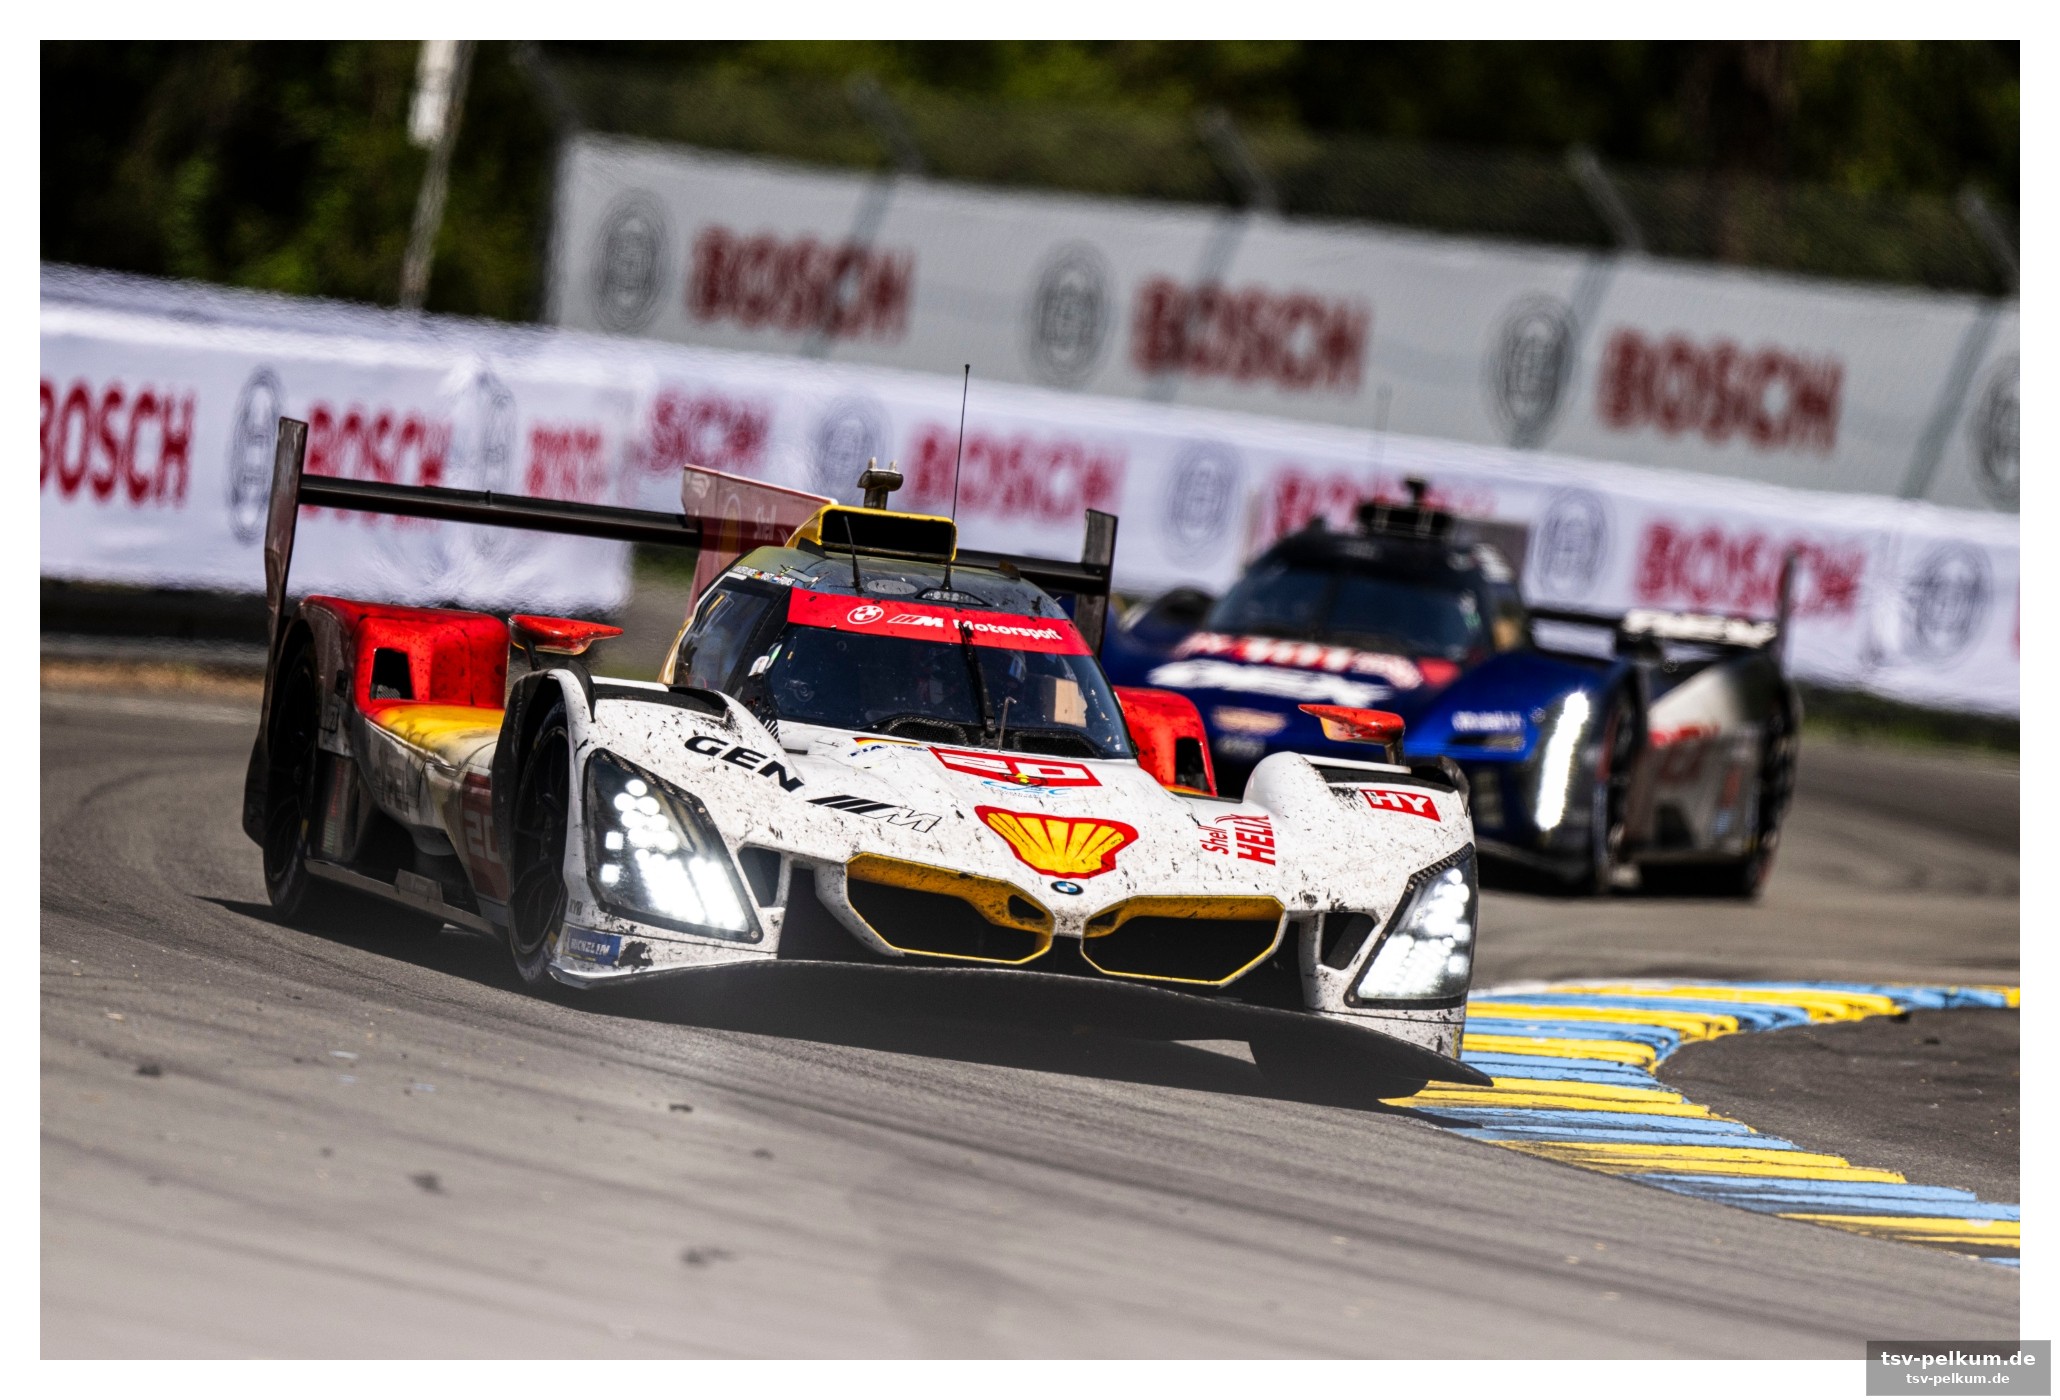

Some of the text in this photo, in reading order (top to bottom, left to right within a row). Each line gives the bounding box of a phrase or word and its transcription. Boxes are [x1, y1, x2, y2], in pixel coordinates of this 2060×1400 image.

[687, 226, 914, 342] BOSCH
[1131, 274, 1370, 393] BOSCH
[1597, 328, 1845, 455] BOSCH
[906, 424, 1126, 523] BOSCH
[953, 619, 1062, 640] Motorsport
[684, 735, 805, 793] GEN
[1371, 791, 1431, 813] HY
[1198, 825, 1229, 856] Shell
[1216, 813, 1277, 866] HELIX
